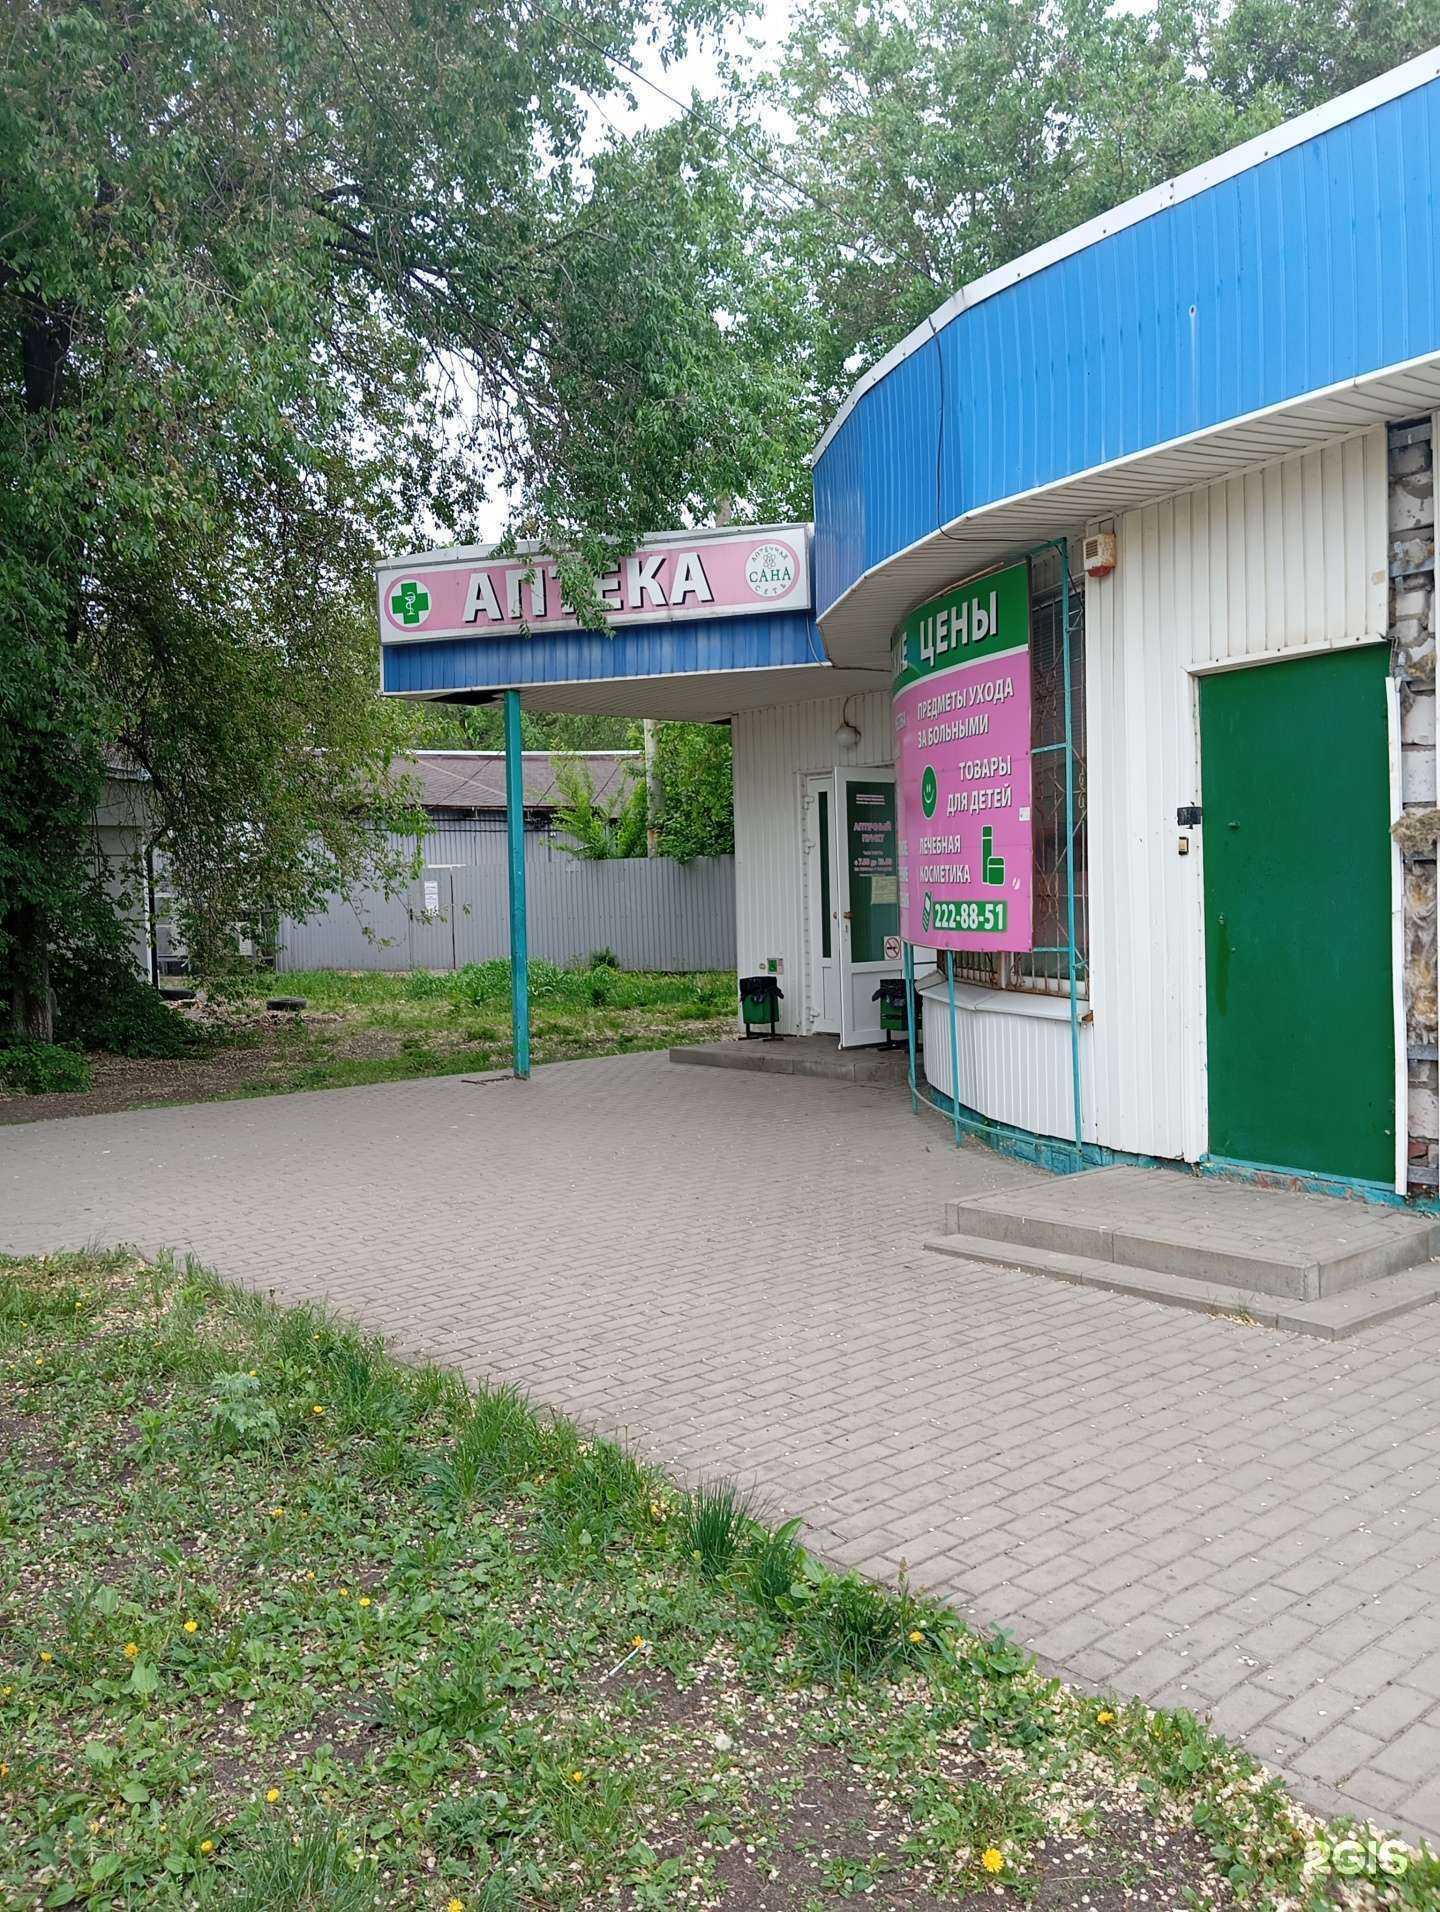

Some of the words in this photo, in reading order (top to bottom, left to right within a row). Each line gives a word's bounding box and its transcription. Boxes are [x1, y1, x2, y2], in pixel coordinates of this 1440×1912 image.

[749, 566, 791, 583] САНА
[920, 591, 998, 667] ЦЕНЫ
[917, 689, 966, 721] ПРЕДМЕТЫ
[969, 677, 1013, 706] УХОДА
[918, 728, 927, 748] ЗА
[928, 714, 989, 746] БОЛЬНЫМИ
[959, 755, 1011, 781] ТОВАРЫ
[947, 793, 968, 816] ДЛЯ
[970, 784, 1012, 815] ДЕТЕЙ
[919, 835, 960, 855] ЛЕЧЕБНАЯ
[919, 865, 971, 884] КОСМЕТИКА
[935, 903, 1004, 930] 222-88-51
